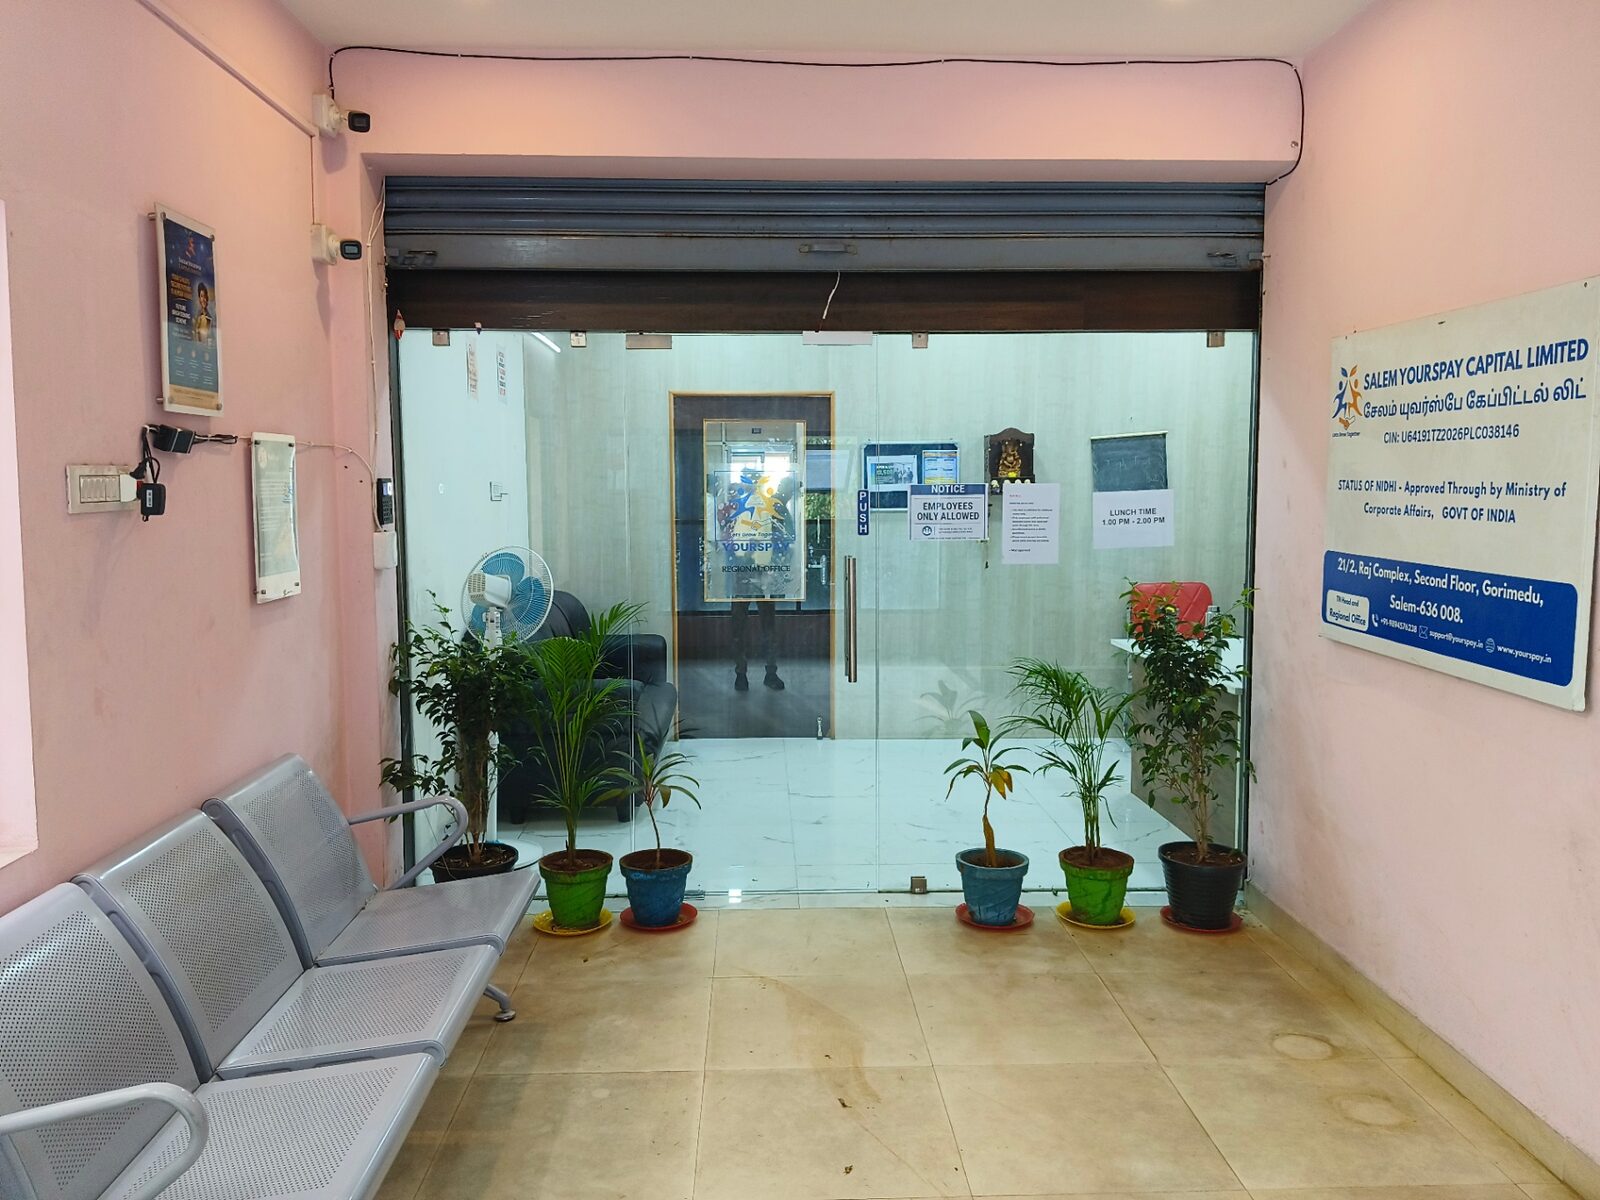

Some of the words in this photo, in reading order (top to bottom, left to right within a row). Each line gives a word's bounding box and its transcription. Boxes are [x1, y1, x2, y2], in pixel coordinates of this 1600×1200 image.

[1363, 369, 1398, 390] SALEM
[1399, 359, 1464, 386] YOURSPAY
[1466, 349, 1523, 376] CAPITAL
[1527, 338, 1589, 368] LIMITED
[1363, 399, 1398, 418] சேலம்
[1399, 392, 1463, 420] யுவர்ஸ்பே
[1466, 382, 1549, 409] கேப்பிட்டல்
[1553, 376, 1587, 401] லிட்
[1383, 432, 1400, 443] CIN:
[931, 484, 966, 493] NOTICE
[1338, 479, 1362, 491] STATUS
[1364, 480, 1374, 491] OF
[1375, 480, 1397, 492] NIDHI
[1404, 481, 1445, 496] Approved
[1448, 481, 1487, 498] Through
[1490, 481, 1502, 499] by
[1505, 482, 1550, 500] Ministry
[1554, 482, 1567, 497] of
[859, 491, 867, 533] PUSH
[922, 501, 973, 511] EMPLOYEES
[1109, 508, 1137, 517] LUNCH
[1138, 507, 1157, 515] TIME
[1363, 502, 1401, 517] Corporate
[1403, 504, 1434, 520] Affairs,
[1442, 506, 1468, 520] GOVT
[1471, 507, 1484, 521] OF
[1487, 508, 1516, 523] INDIA
[916, 512, 939, 521] ONLY
[940, 511, 980, 520] ALLOWED
[1102, 518, 1117, 526] 1.00
[1136, 517, 1152, 525] 2.00
[1153, 516, 1165, 524] PM
[722, 542, 790, 552] YOURSPAY
[721, 565, 761, 573] REGIONAL
[1337, 557, 1358, 576] 21/2,
[1359, 560, 1372, 579] Raj
[1373, 563, 1412, 585] Complex,
[1414, 569, 1448, 589] Second
[1450, 574, 1479, 596] Floor,
[1482, 579, 1544, 608] Gorimedu,
[1329, 608, 1351, 622] Regional
[1351, 613, 1366, 626] Office
[1389, 594, 1438, 618] Salem-636
[1440, 604, 1463, 623] 008.
[1497, 645, 1552, 664] www.yourspay.in
